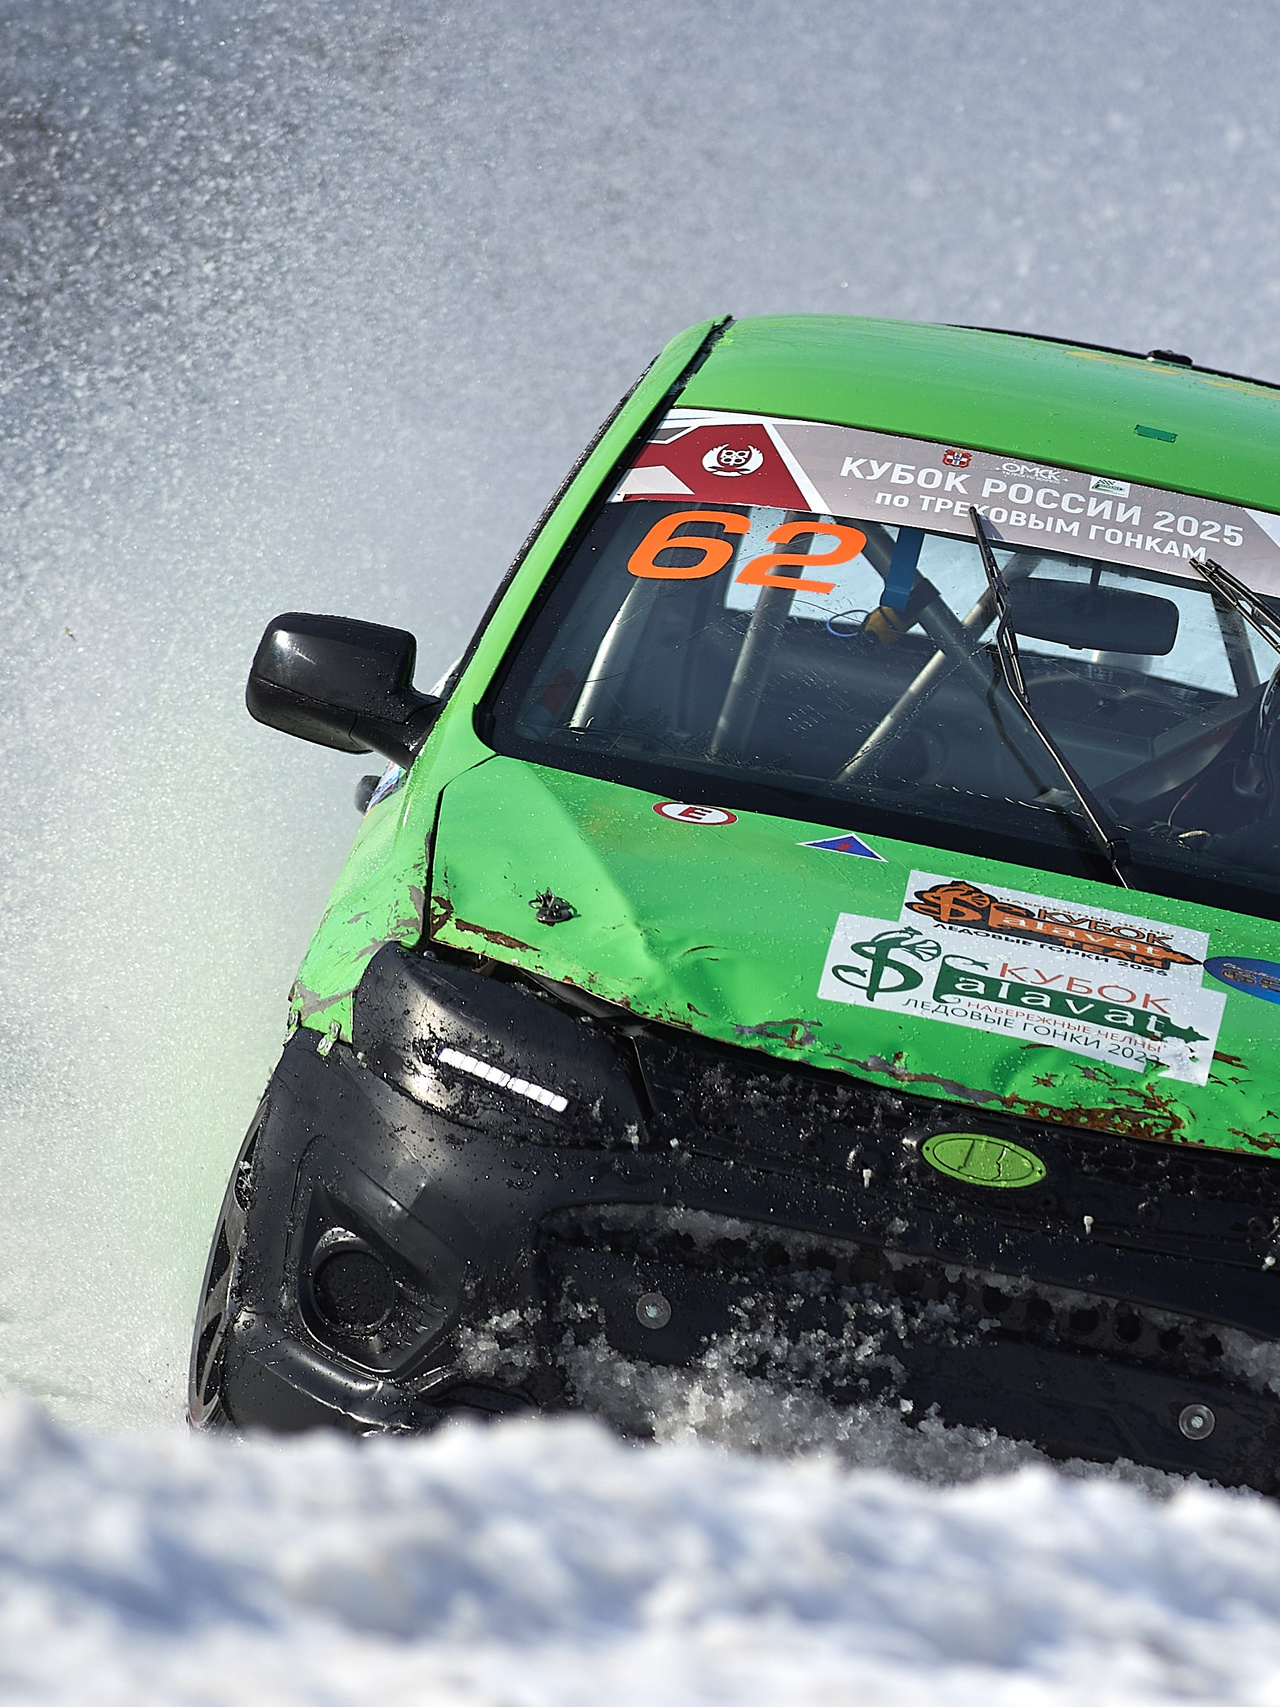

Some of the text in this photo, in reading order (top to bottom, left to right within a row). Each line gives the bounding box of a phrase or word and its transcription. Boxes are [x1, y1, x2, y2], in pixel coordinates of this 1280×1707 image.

[1002, 462, 1061, 481] ОМСК
[840, 457, 1245, 548] КУБОК РОССИИ 2025
[627, 510, 867, 595] 62
[920, 495, 1079, 538] ТРЕКОВЫМ
[1089, 525, 1207, 564] ГОНКАМ
[933, 923, 1033, 947] ЛЕДОВЫЕ
[1040, 943, 1110, 963] ГОНКИ
[1038, 908, 1174, 948] КУБОК
[999, 962, 1172, 1015] КУБОК
[901, 998, 1015, 1029] ЛЕДОВЫЕ
[1023, 1022, 1101, 1049] ГОНКИ
[967, 1001, 1161, 1053] НАБЕРЕЖНЫЕ ЧЕЛНЫ
